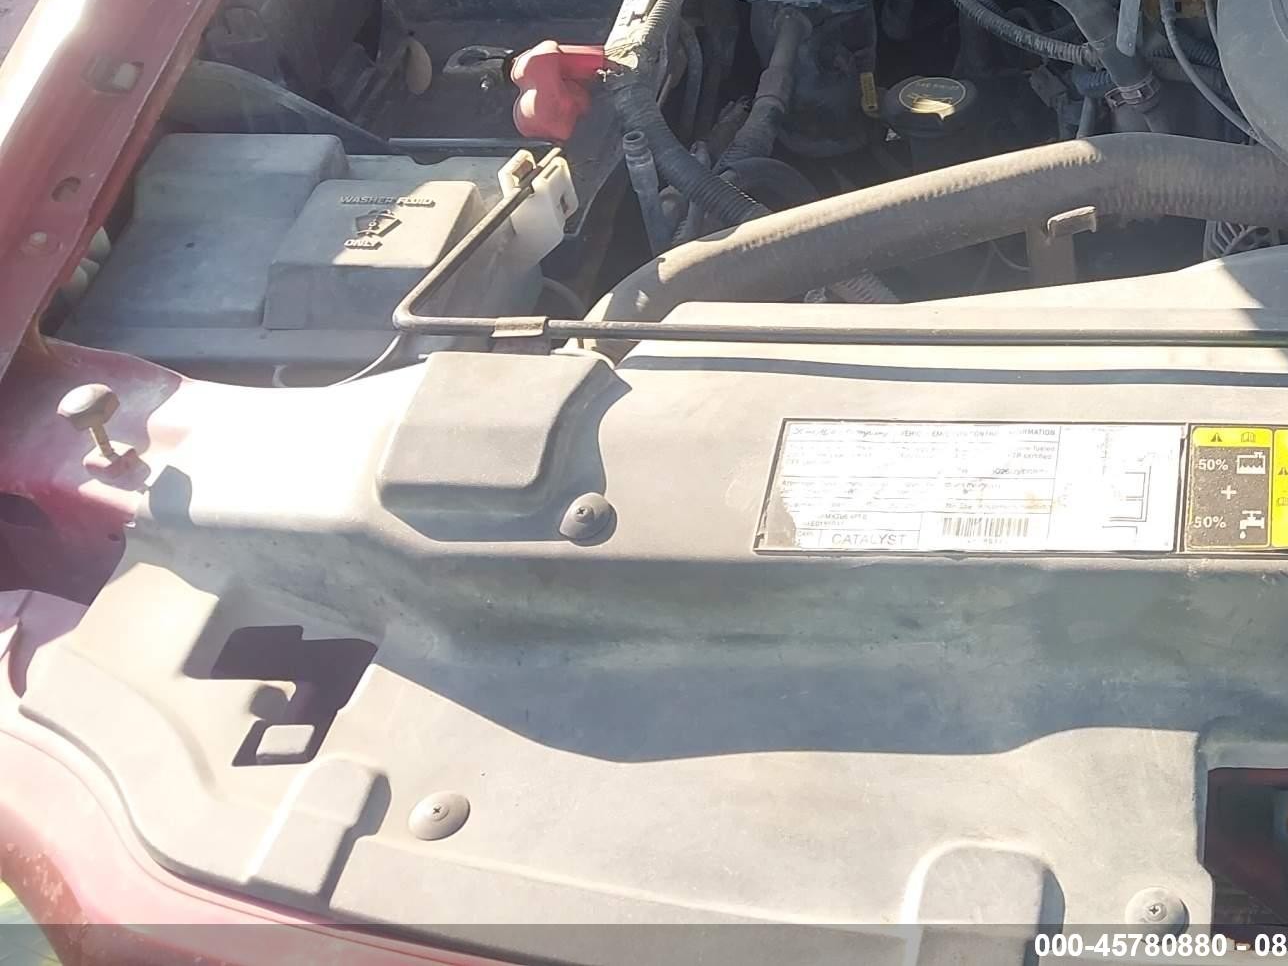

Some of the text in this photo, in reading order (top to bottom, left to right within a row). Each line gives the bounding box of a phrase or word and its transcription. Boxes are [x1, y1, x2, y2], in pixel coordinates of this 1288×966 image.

[340, 195, 434, 206] WASHER FLUID
[343, 238, 381, 248] ONLY
[1198, 458, 1229, 472] 50%
[1193, 516, 1227, 529] 50%
[831, 532, 908, 546] CATALYST
